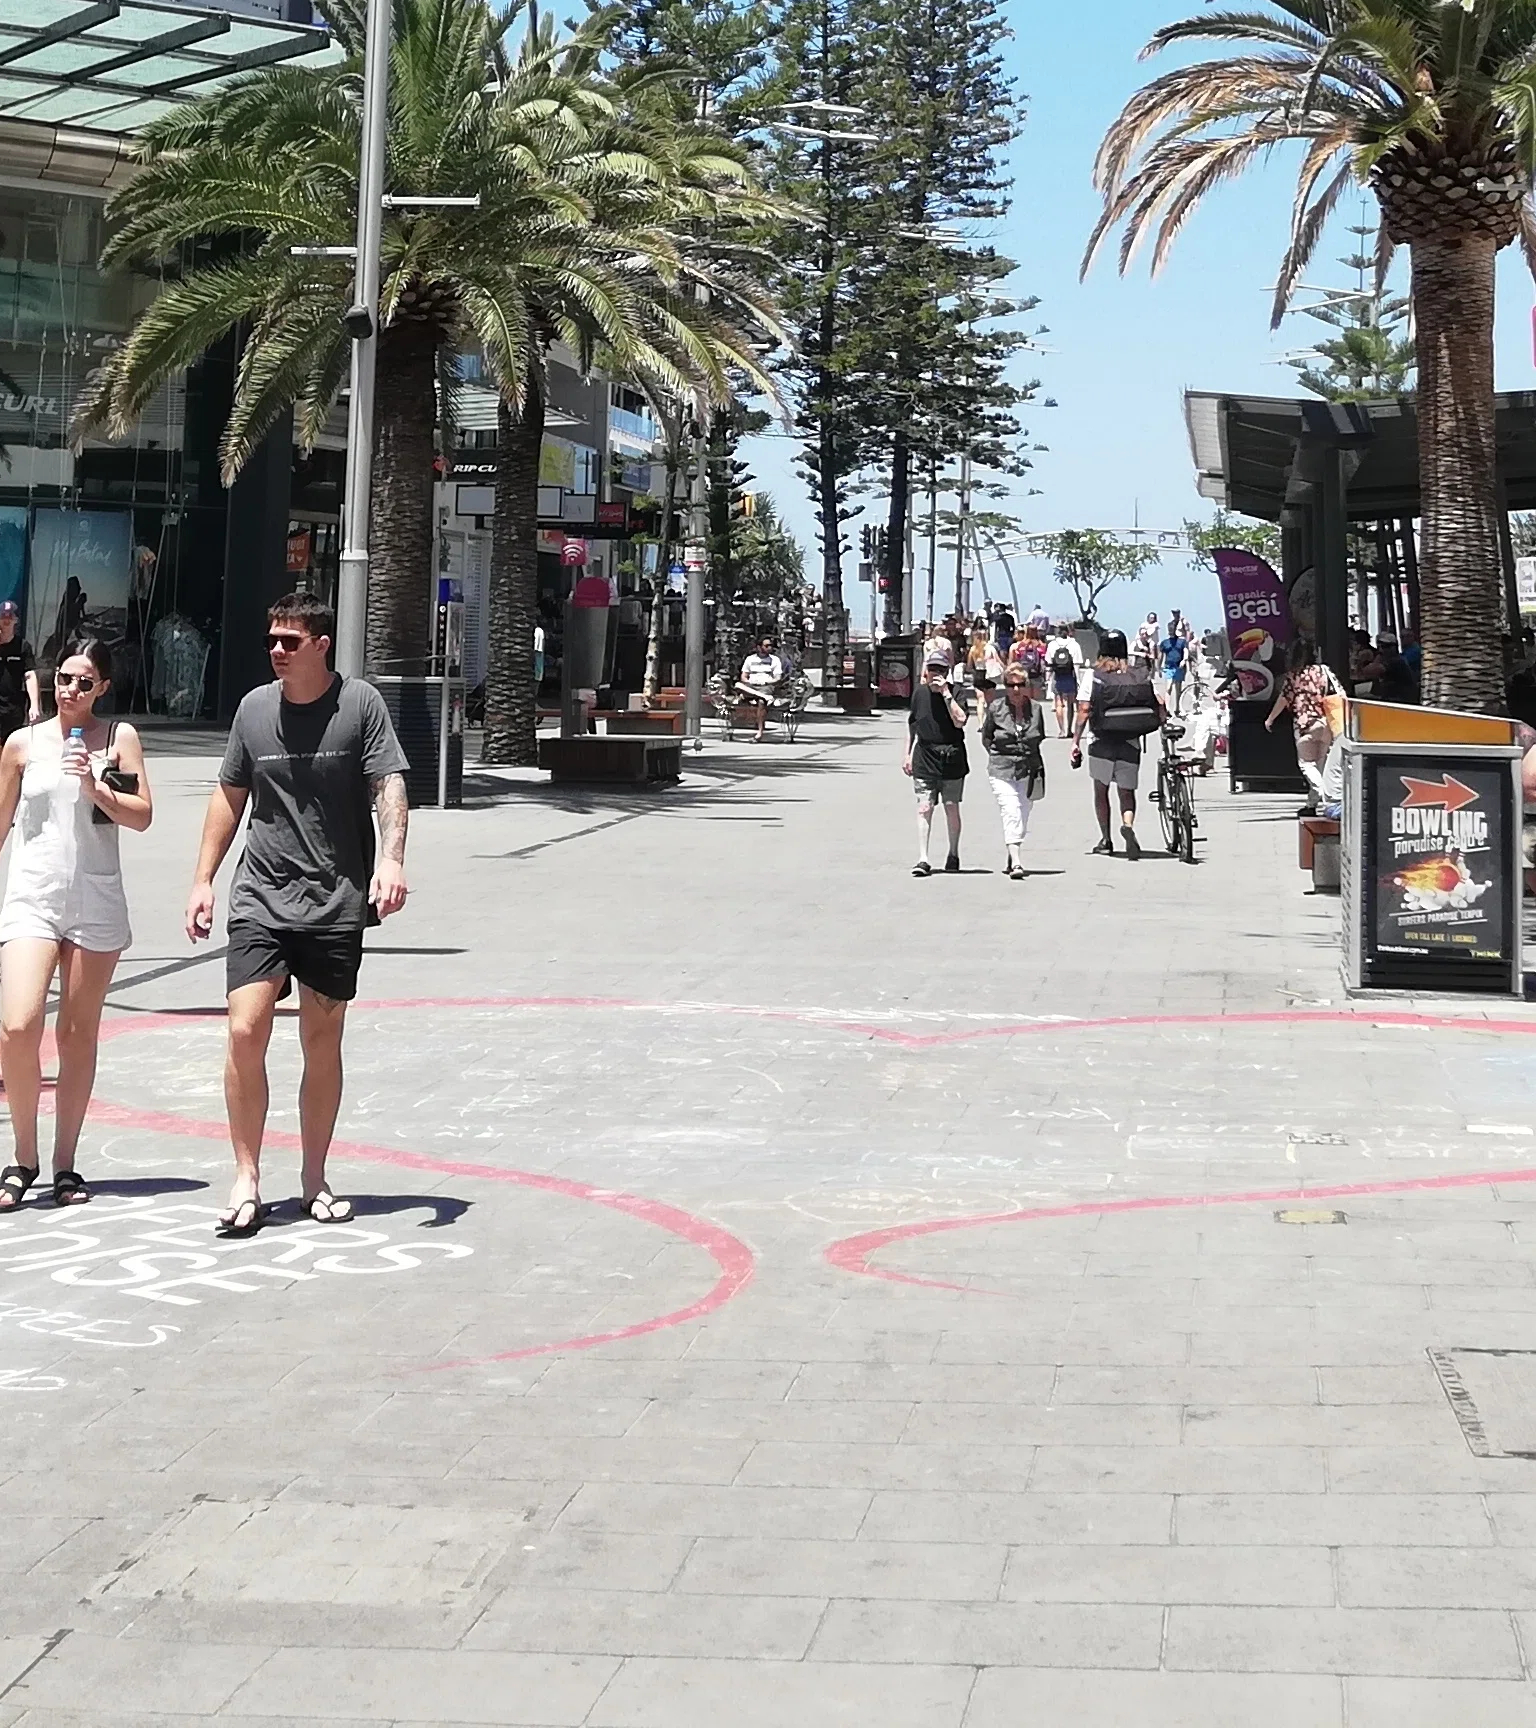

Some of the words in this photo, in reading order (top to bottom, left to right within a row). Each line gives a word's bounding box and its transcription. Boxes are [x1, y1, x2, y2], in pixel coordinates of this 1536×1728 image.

[453, 464, 477, 473] RIP
[477, 464, 498, 473] CU
[1227, 590, 1267, 602] organic
[1391, 807, 1488, 839] BOWLING
[1394, 837, 1443, 858] paradise
